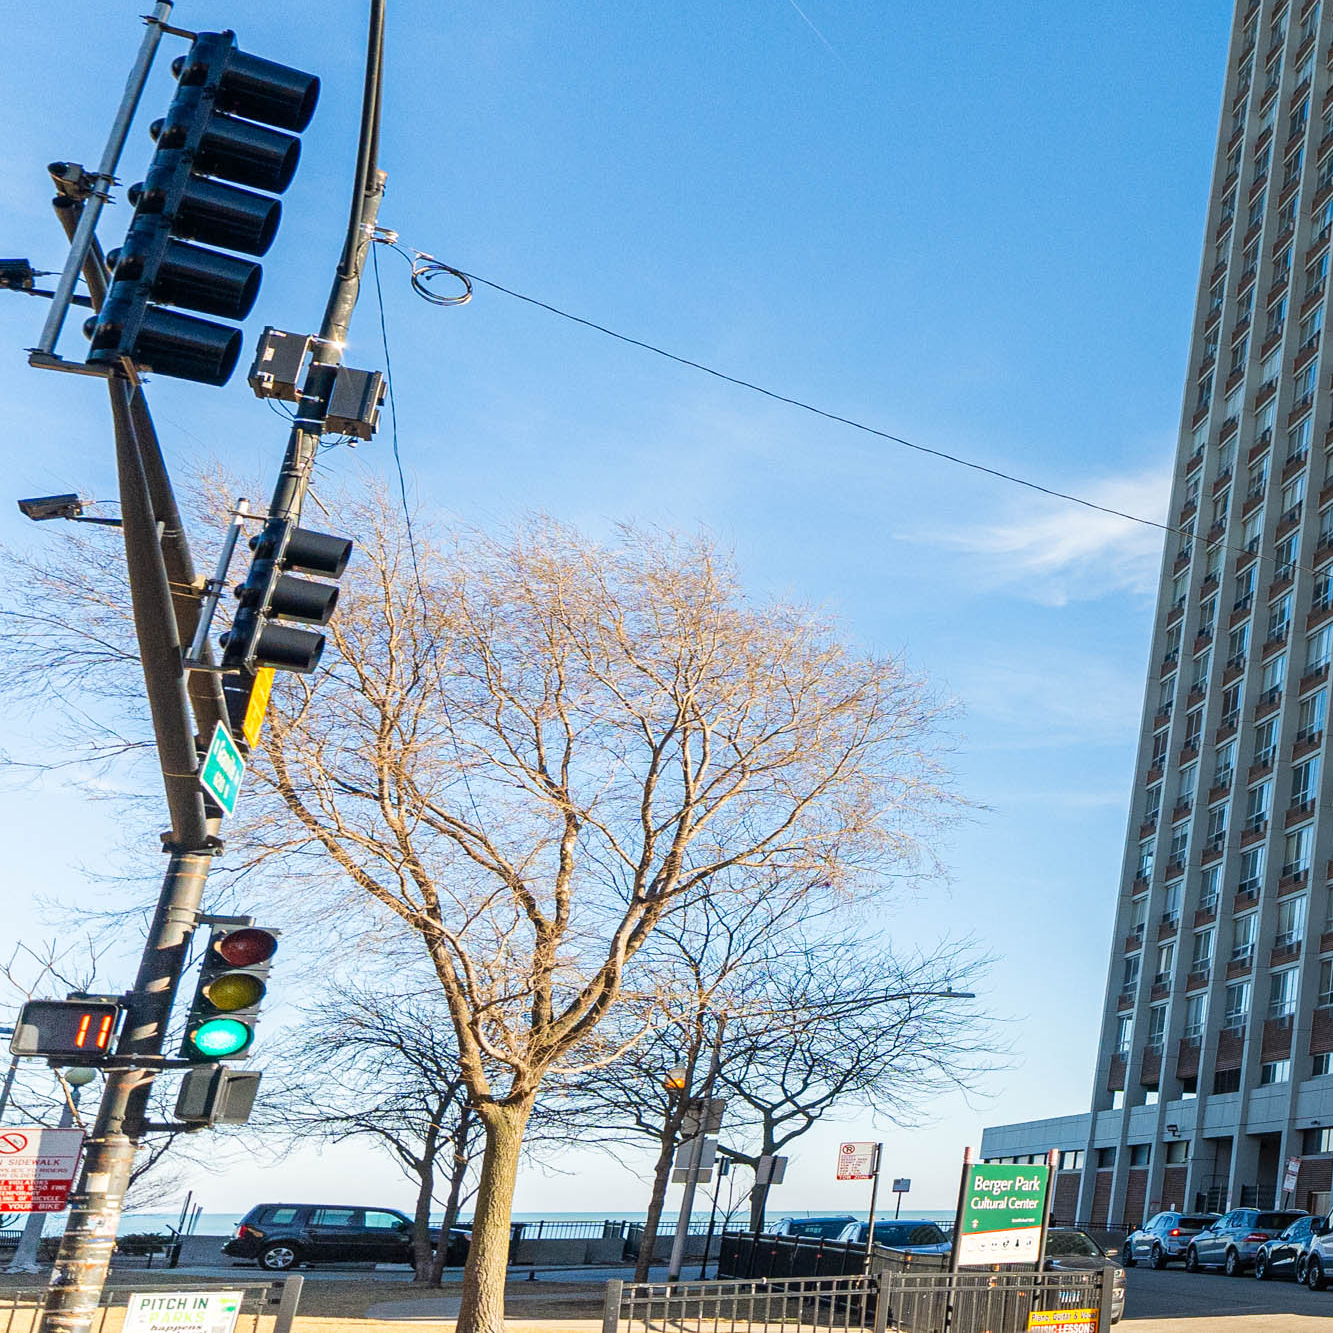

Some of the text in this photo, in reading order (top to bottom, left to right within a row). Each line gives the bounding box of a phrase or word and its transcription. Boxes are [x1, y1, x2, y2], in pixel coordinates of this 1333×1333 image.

[75, 1014, 112, 1048] 11
[974, 1175, 1041, 1196] Berger Park
[970, 1191, 1040, 1209] Cultural Center
[140, 1297, 209, 1310] PITCH IN
[149, 1311, 206, 1323] PARKS
[1058, 1322, 1096, 1333] LESSONS
